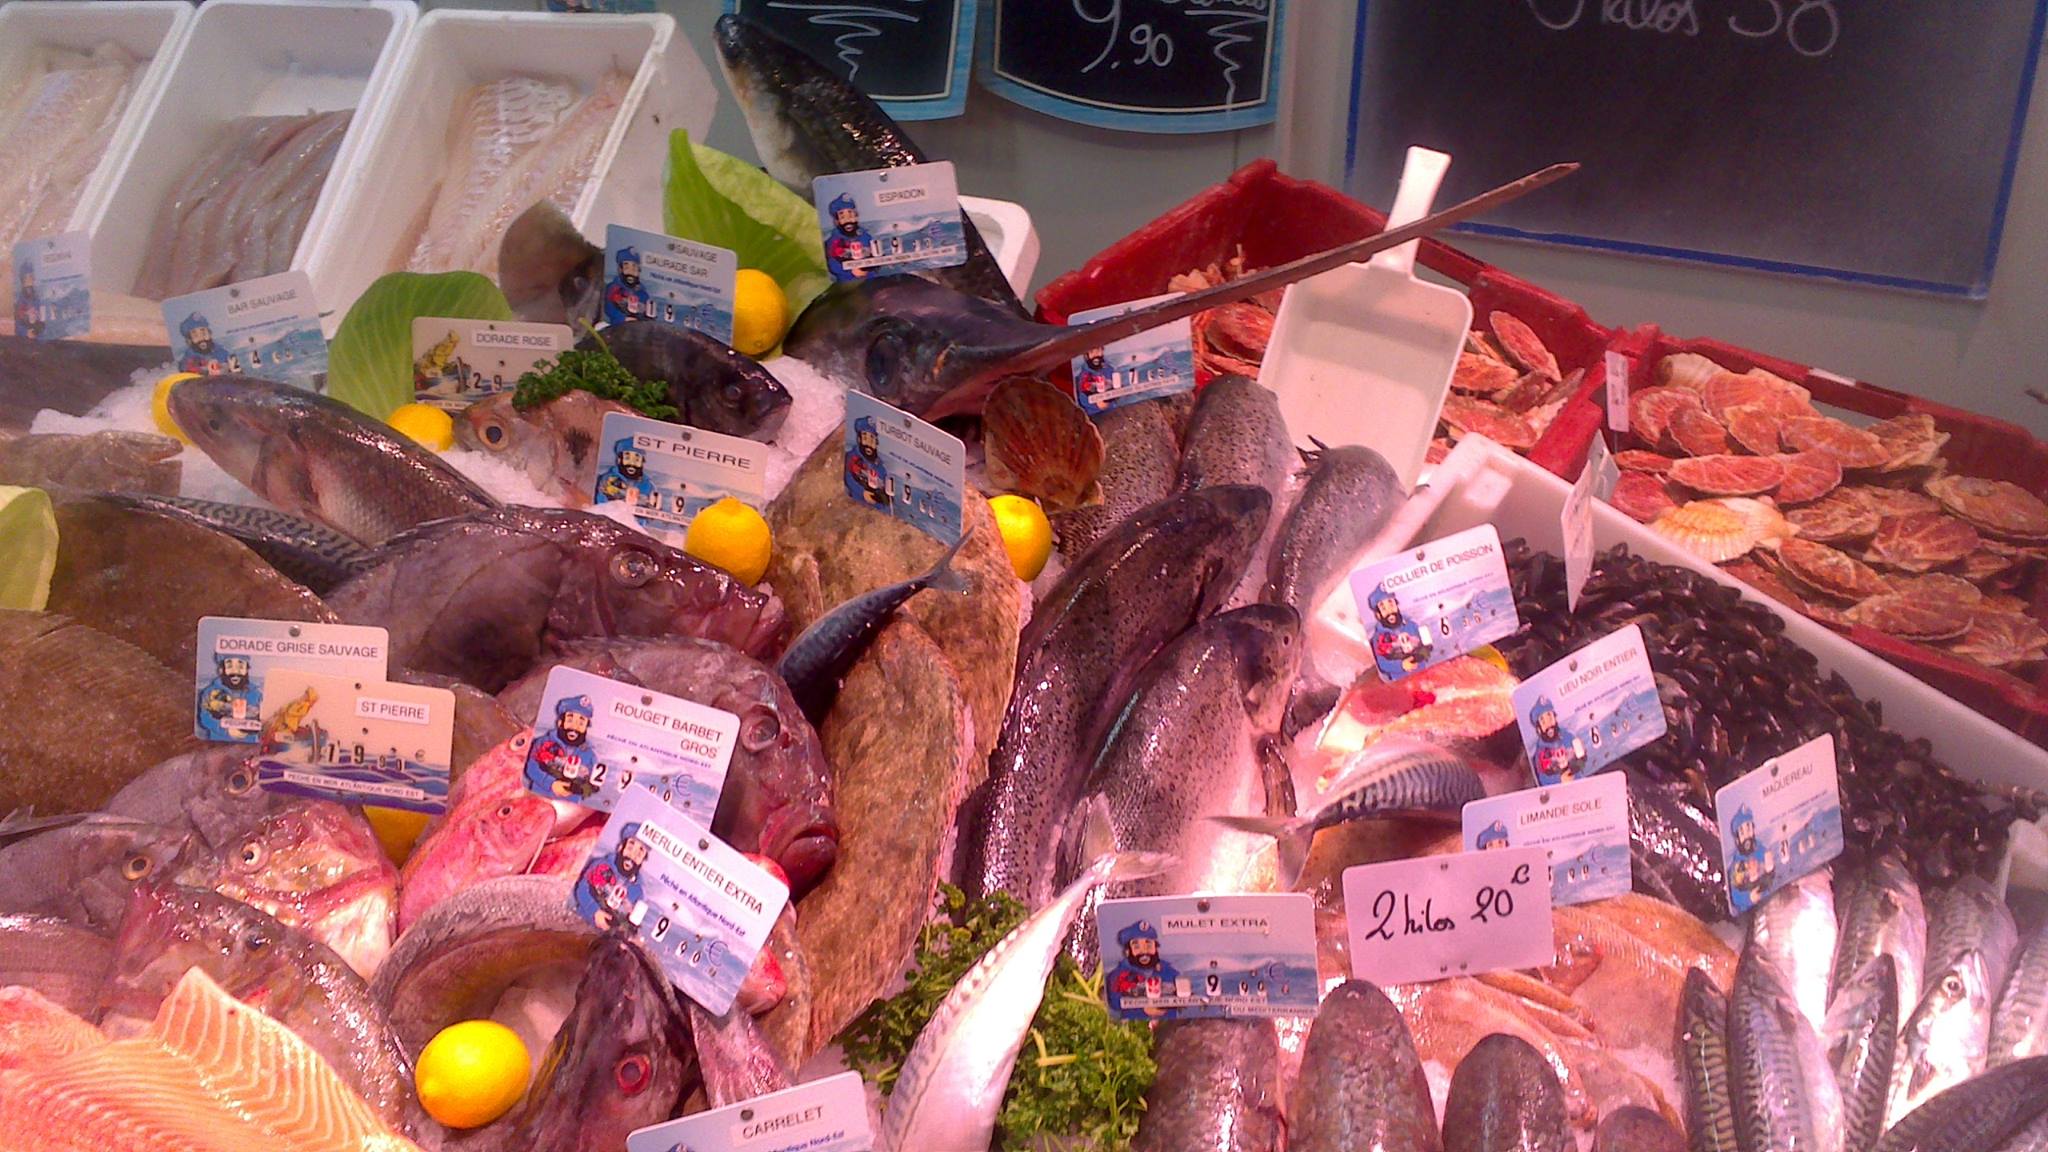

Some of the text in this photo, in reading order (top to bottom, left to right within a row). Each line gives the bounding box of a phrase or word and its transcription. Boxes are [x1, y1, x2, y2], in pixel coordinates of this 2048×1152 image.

[1073, 0, 1174, 74] 9.90
[879, 188, 926, 203] ESPADON
[646, 253, 709, 279] DAURADE SAR
[675, 243, 719, 264] SAUVAGE
[227, 287, 298, 316] BAR SAUVAGE
[475, 332, 553, 348] DORADE ROSE
[636, 435, 752, 469] ST PIERRE
[880, 420, 952, 466] TURBOT SAUVAGE
[1386, 565, 1429, 589] COLLIER
[1430, 560, 1444, 573] DE
[1446, 543, 1494, 569] POISSON
[219, 638, 378, 658] DORADE GRISE SAUVAGE
[1558, 678, 1580, 698] LIEU
[1580, 664, 1603, 691] NOIR
[1602, 647, 1638, 677] ENTIER
[360, 701, 425, 720] ST PIERRE
[614, 700, 724, 744] ROUGET BARBET
[680, 738, 719, 760] GROS
[1762, 763, 1814, 798] MAQUEREAU
[1519, 797, 1602, 826] LIMANDE SOLE
[641, 823, 764, 916] MERLU ENTIER EXTRA
[655, 916, 670, 938] 9
[1167, 917, 1269, 929] MULET EXTRA
[1364, 889, 1397, 941] 2
[1403, 894, 1456, 936] kilos
[1206, 973, 1220, 993] 9
[742, 1108, 822, 1140] CARRELET
